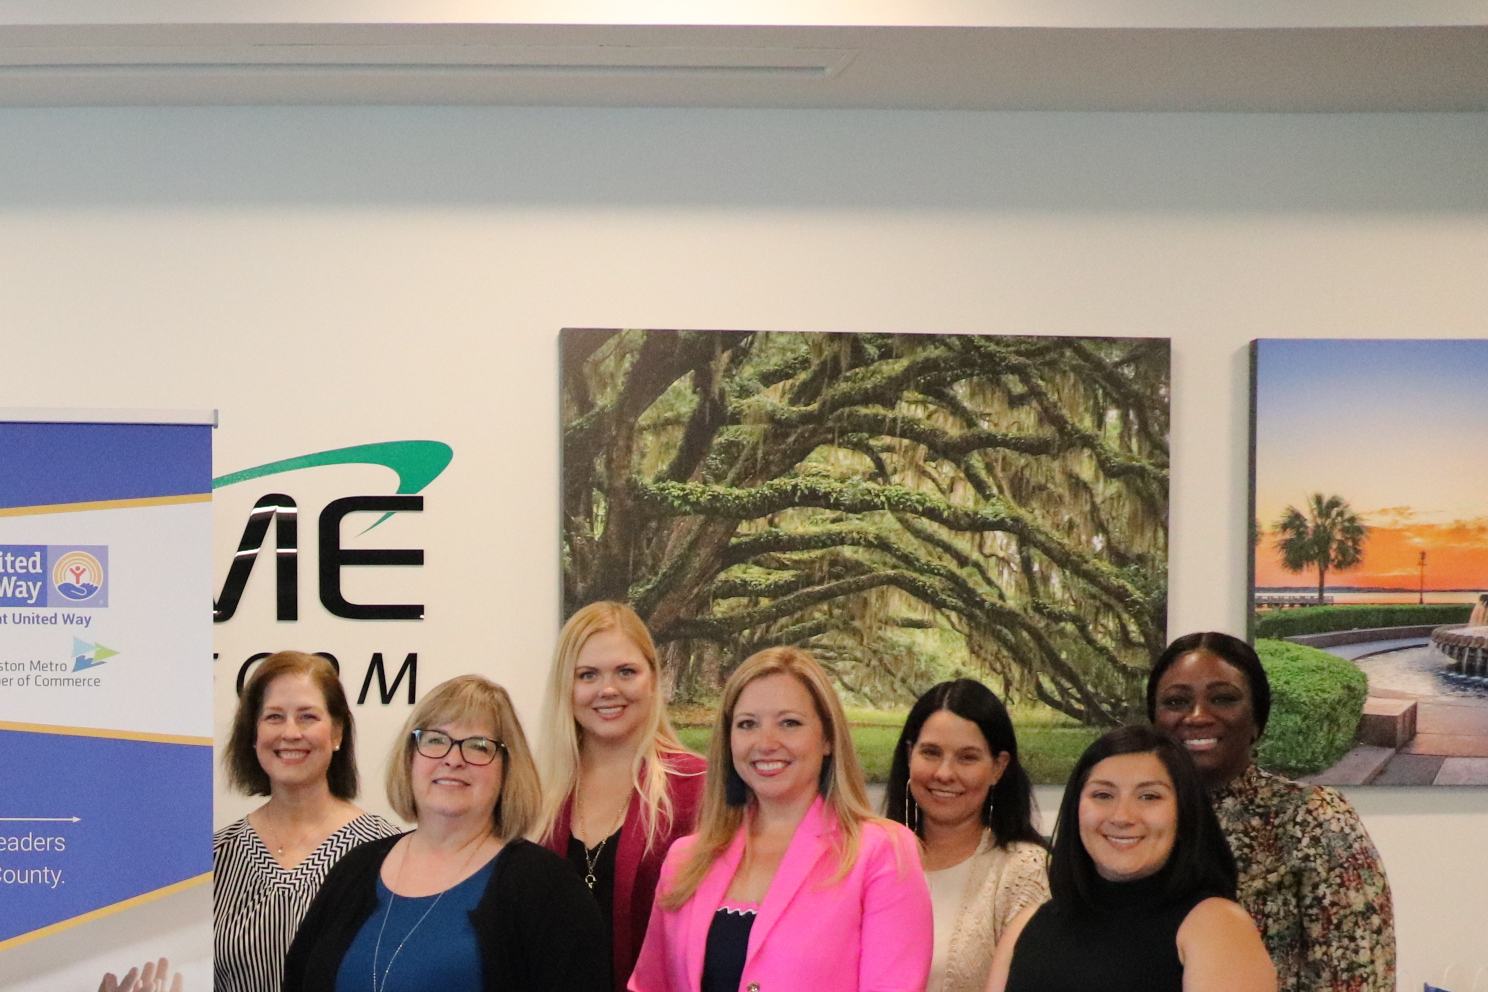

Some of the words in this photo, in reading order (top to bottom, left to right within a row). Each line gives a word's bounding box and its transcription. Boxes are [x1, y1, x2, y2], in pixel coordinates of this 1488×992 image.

[12, 613, 58, 626] United
[62, 613, 92, 628] Way
[29, 660, 67, 672] Metro
[17, 674, 30, 686] of
[34, 675, 101, 687] Commerce
